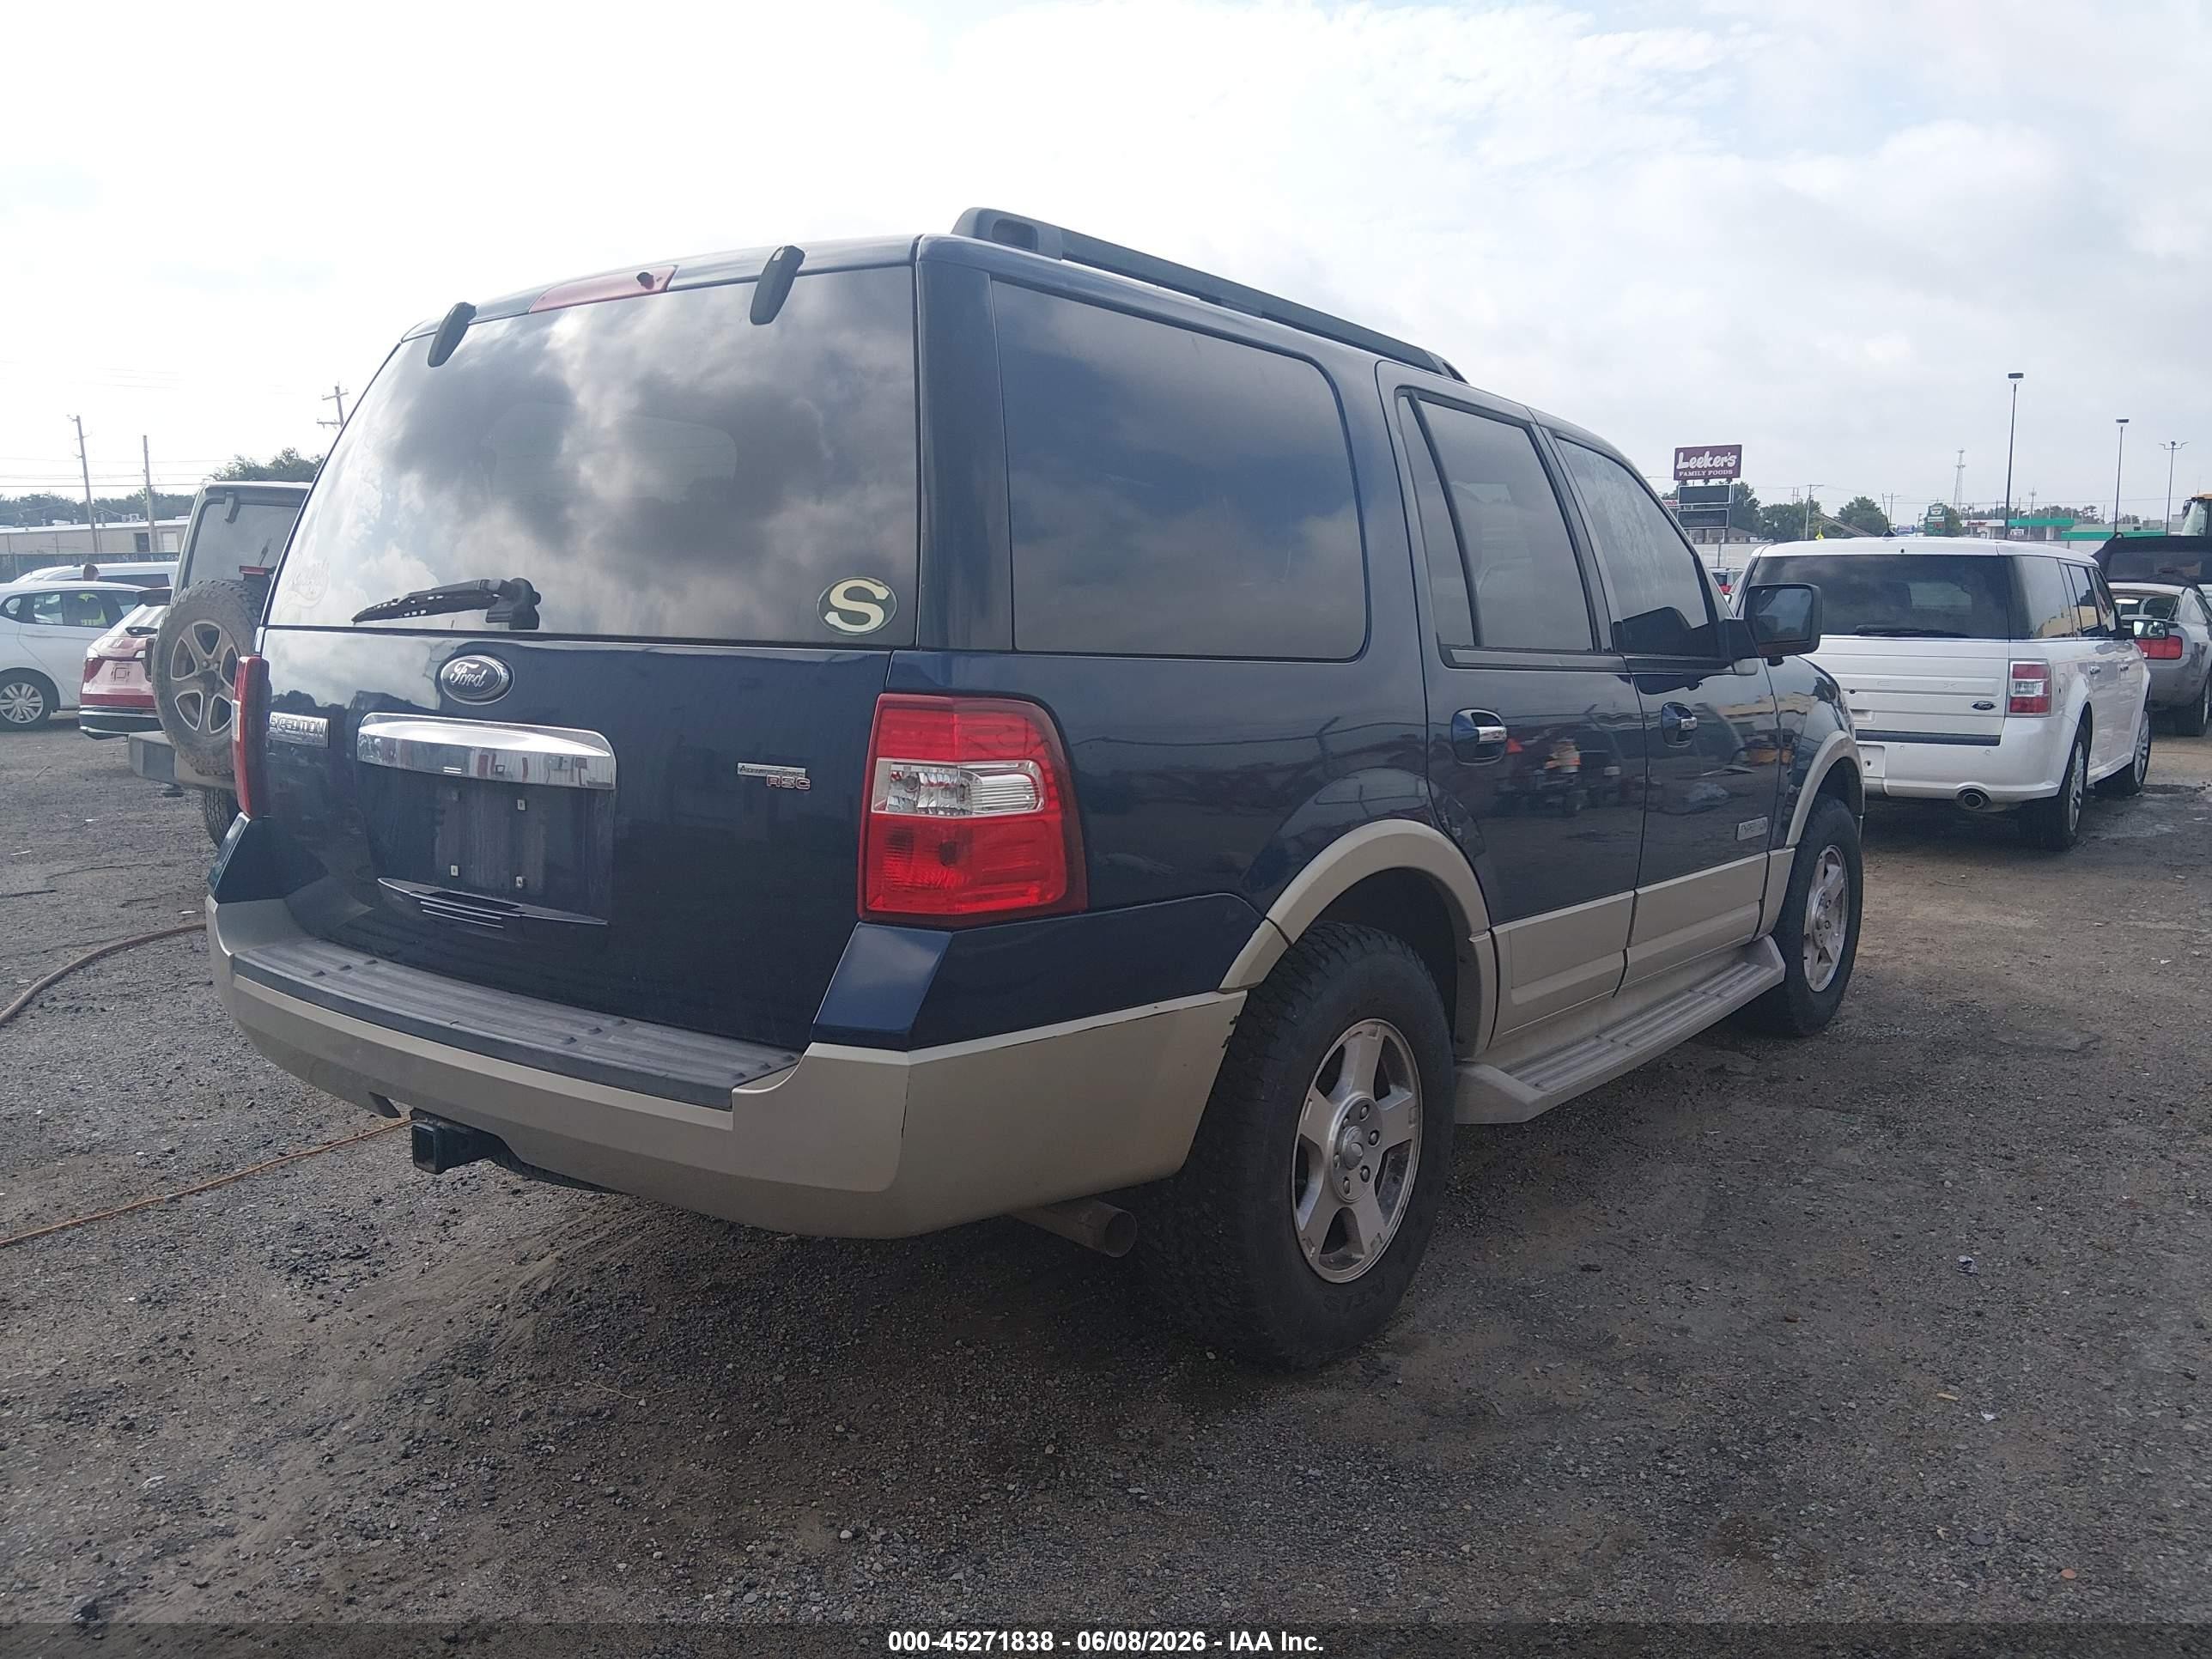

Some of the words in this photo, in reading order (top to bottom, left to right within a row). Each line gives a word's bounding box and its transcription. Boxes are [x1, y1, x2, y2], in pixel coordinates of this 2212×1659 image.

[1676, 451, 1738, 469] Leeker's
[824, 579, 890, 633] S
[449, 661, 488, 688] Ford
[270, 714, 327, 736] EXPEDITION
[766, 775, 811, 790] RSC
